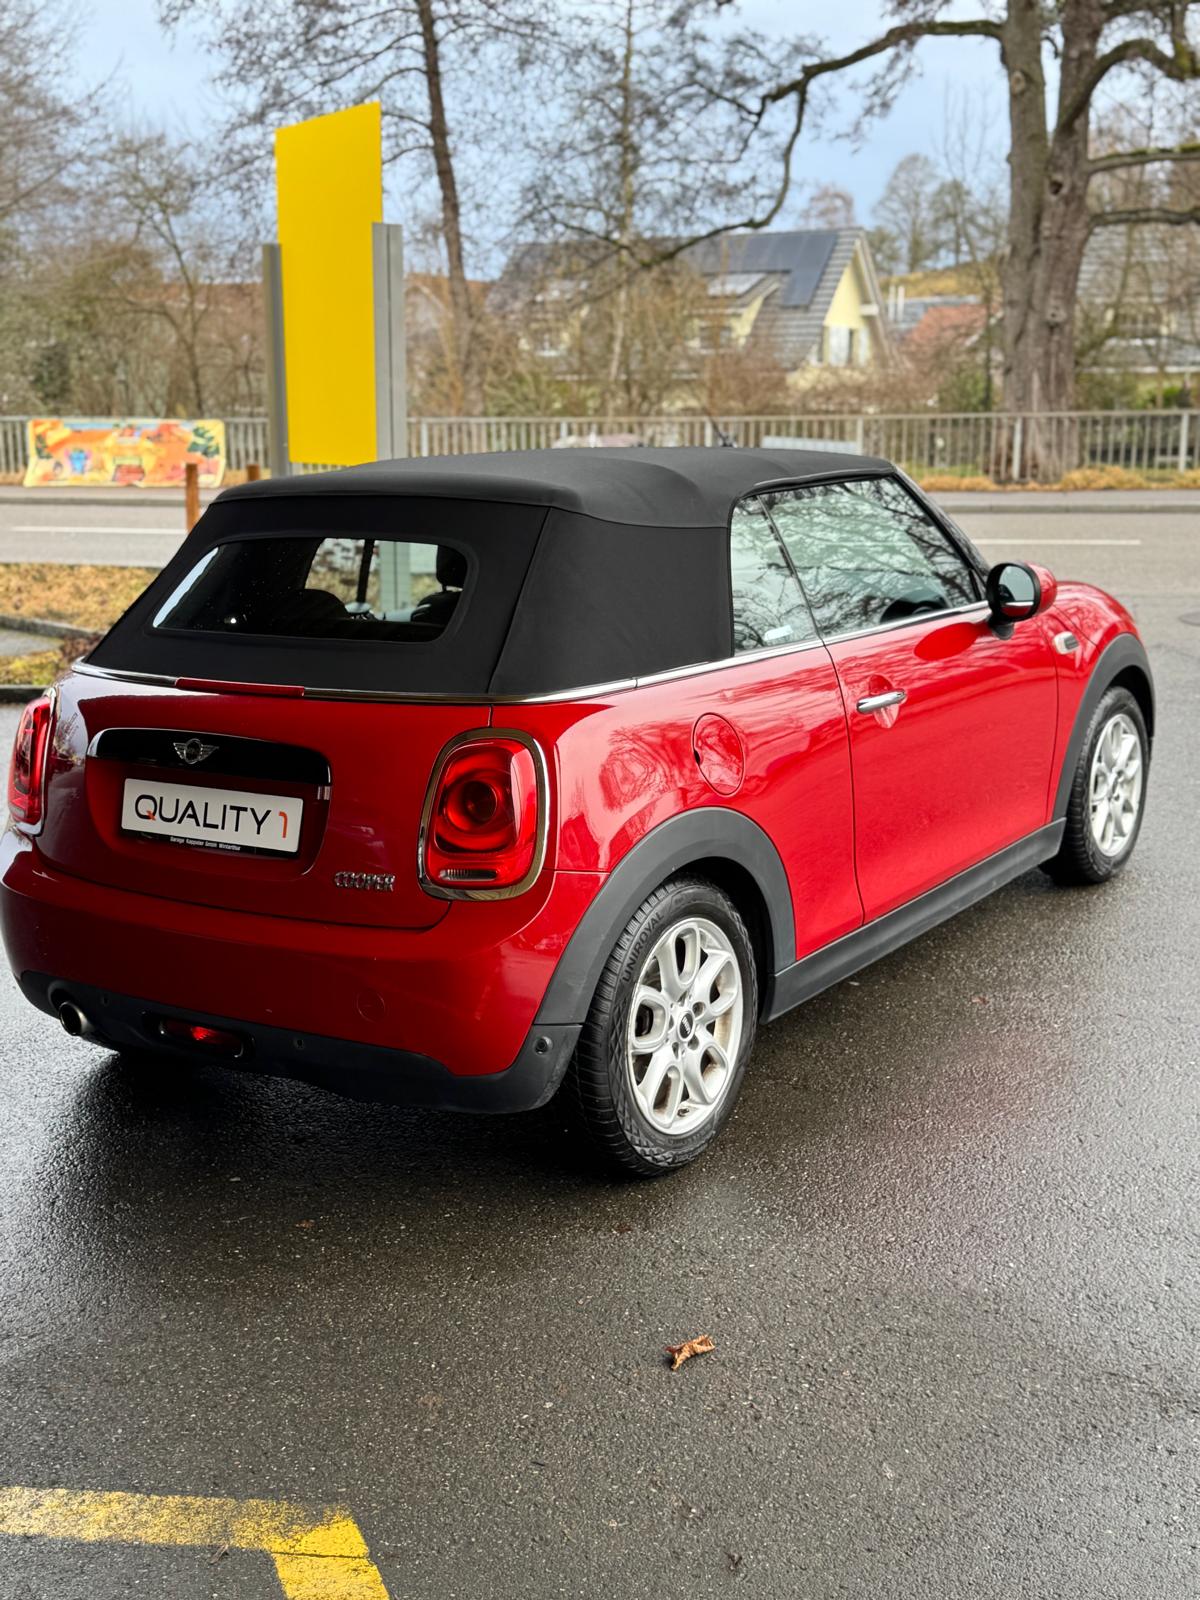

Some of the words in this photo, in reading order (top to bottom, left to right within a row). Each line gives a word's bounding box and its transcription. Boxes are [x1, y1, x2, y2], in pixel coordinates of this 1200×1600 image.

[134, 794, 272, 835] QUALITY
[334, 871, 395, 892] COOPER
[622, 912, 664, 982] UNIROYAL
